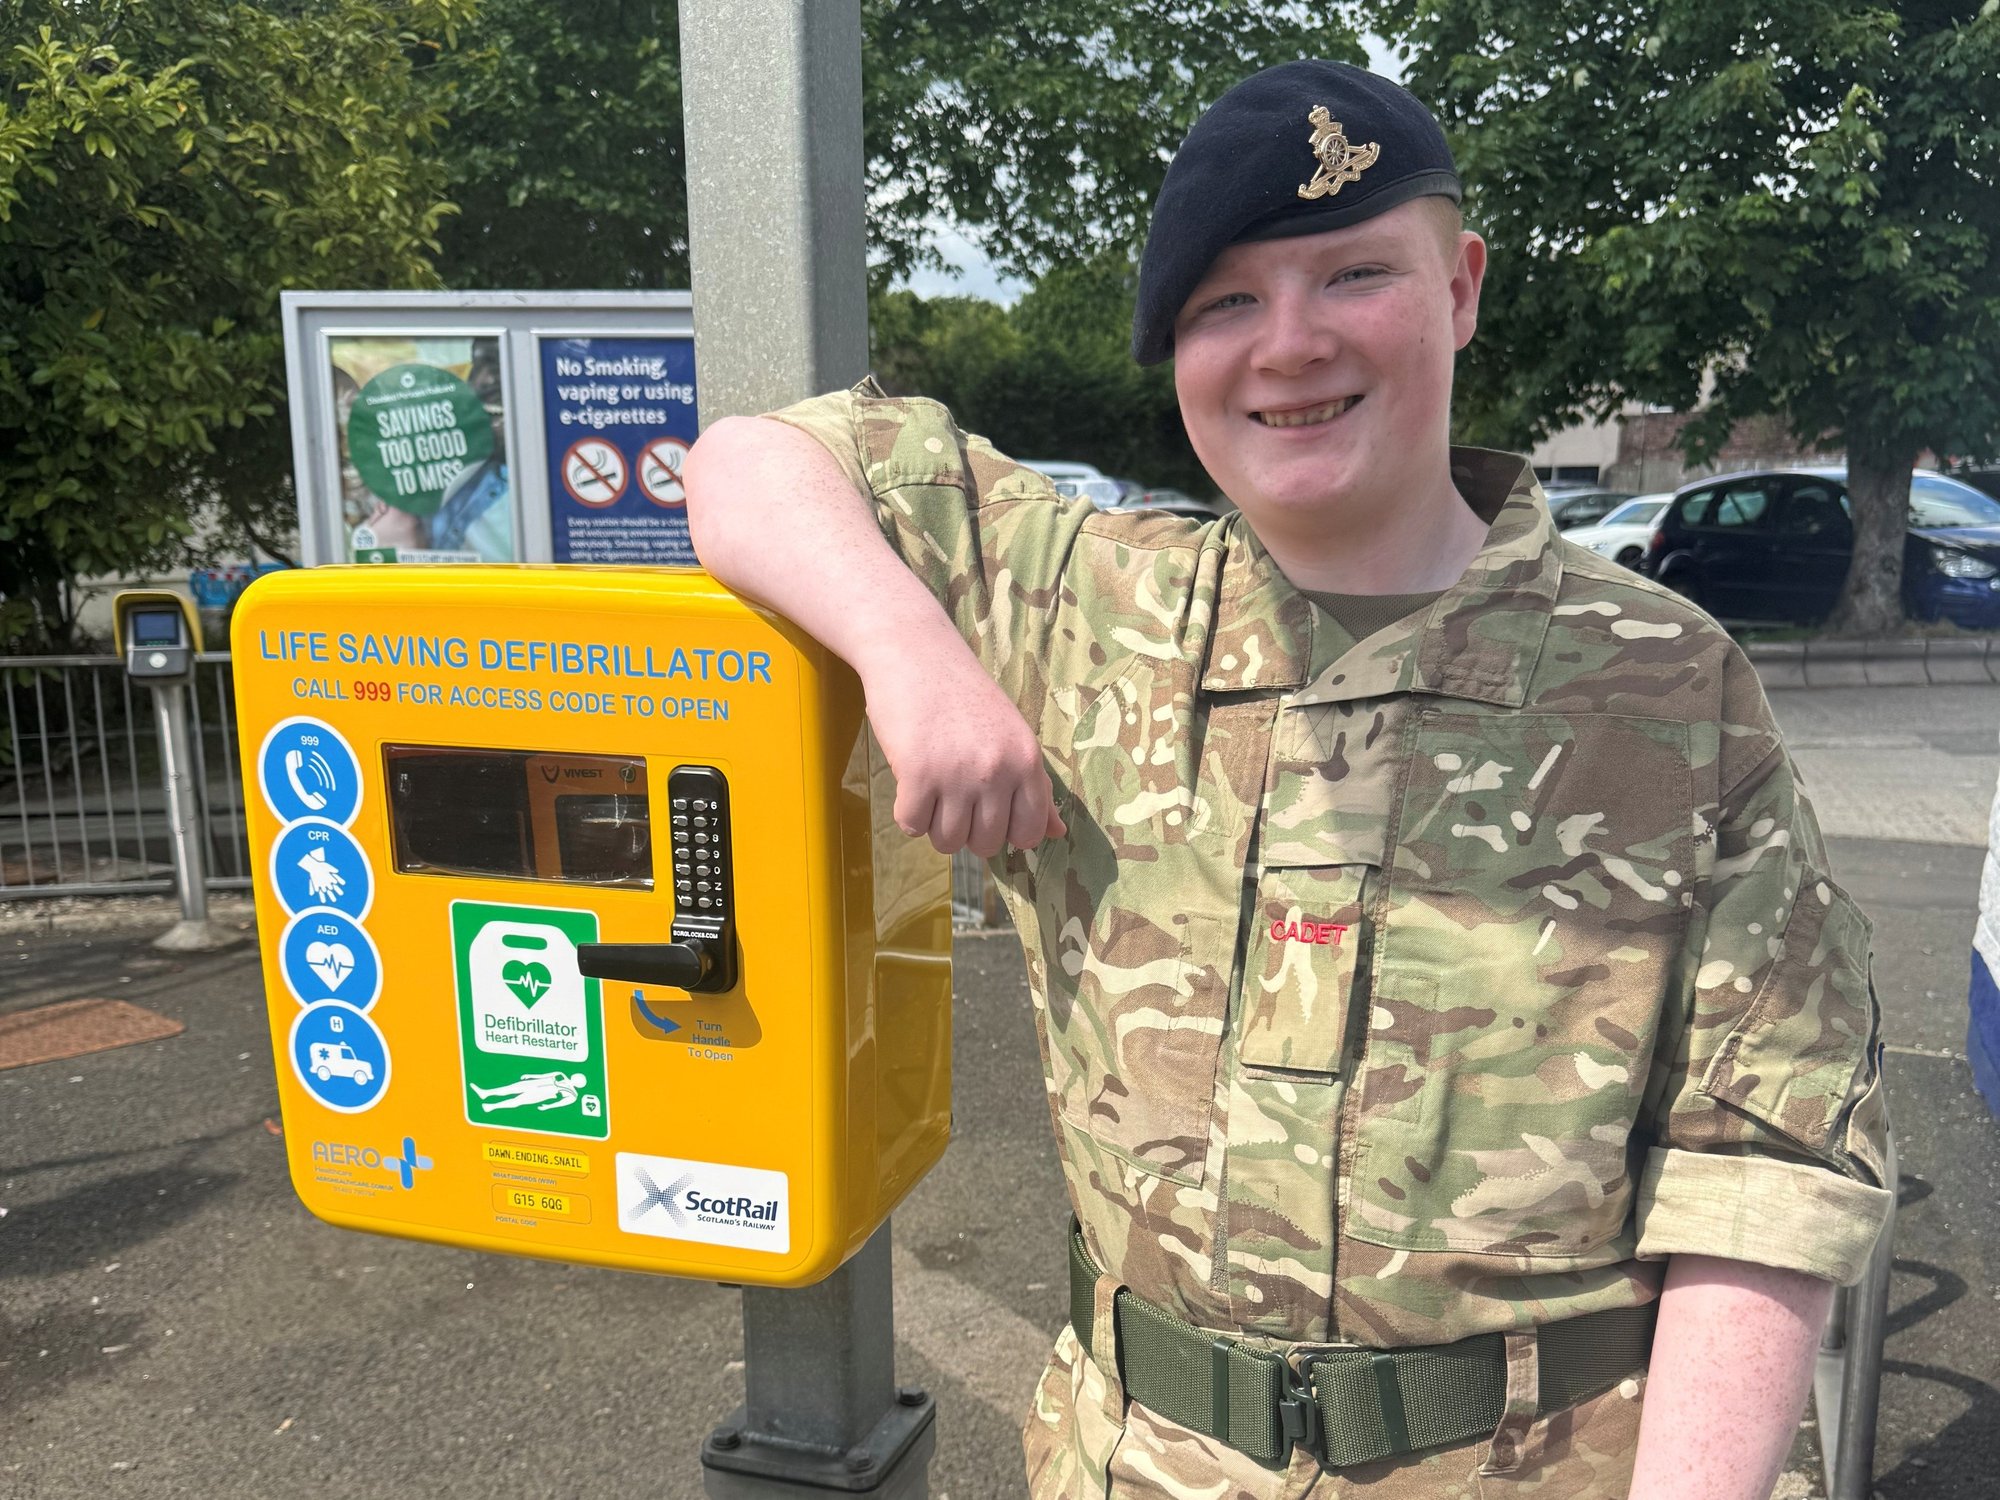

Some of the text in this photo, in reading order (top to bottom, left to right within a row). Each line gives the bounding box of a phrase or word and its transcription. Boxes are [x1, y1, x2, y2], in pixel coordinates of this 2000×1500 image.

[556, 355, 667, 380] No Smoking,
[558, 380, 694, 405] vaping or using
[376, 399, 457, 438] SAVINGS
[560, 405, 667, 429] e-cigarettes
[376, 428, 467, 468] TOO GOOD
[391, 467, 417, 495] TO
[259, 630, 772, 684] LIFE SAVING DEFIBRILLATOR
[292, 677, 729, 721] CALL 999 FOR ACCESS CODE TO OPEN
[300, 735, 320, 746] 999
[564, 768, 605, 778] VIVEST
[710, 801, 718, 810] 6
[711, 817, 718, 826] 7
[308, 830, 330, 841] CPR
[712, 834, 719, 843] 8
[713, 850, 720, 859] 9
[714, 882, 722, 891] Z
[715, 898, 723, 907] C
[317, 925, 339, 936] AED
[1270, 919, 1348, 945] CADET
[332, 1019, 341, 1029] H
[484, 1014, 578, 1038] Defibrillator
[697, 1020, 722, 1032] Turn
[485, 1030, 579, 1051] Heart Restarter
[692, 1033, 731, 1047] Handle
[688, 1047, 733, 1062] To Open
[313, 1140, 381, 1169] AERO
[488, 1147, 582, 1168] DAWN.ENDING.SNAIL
[513, 1192, 563, 1211] G15 6QG
[685, 1189, 779, 1222] ScotRail
[742, 1219, 776, 1232] RAILWAY
